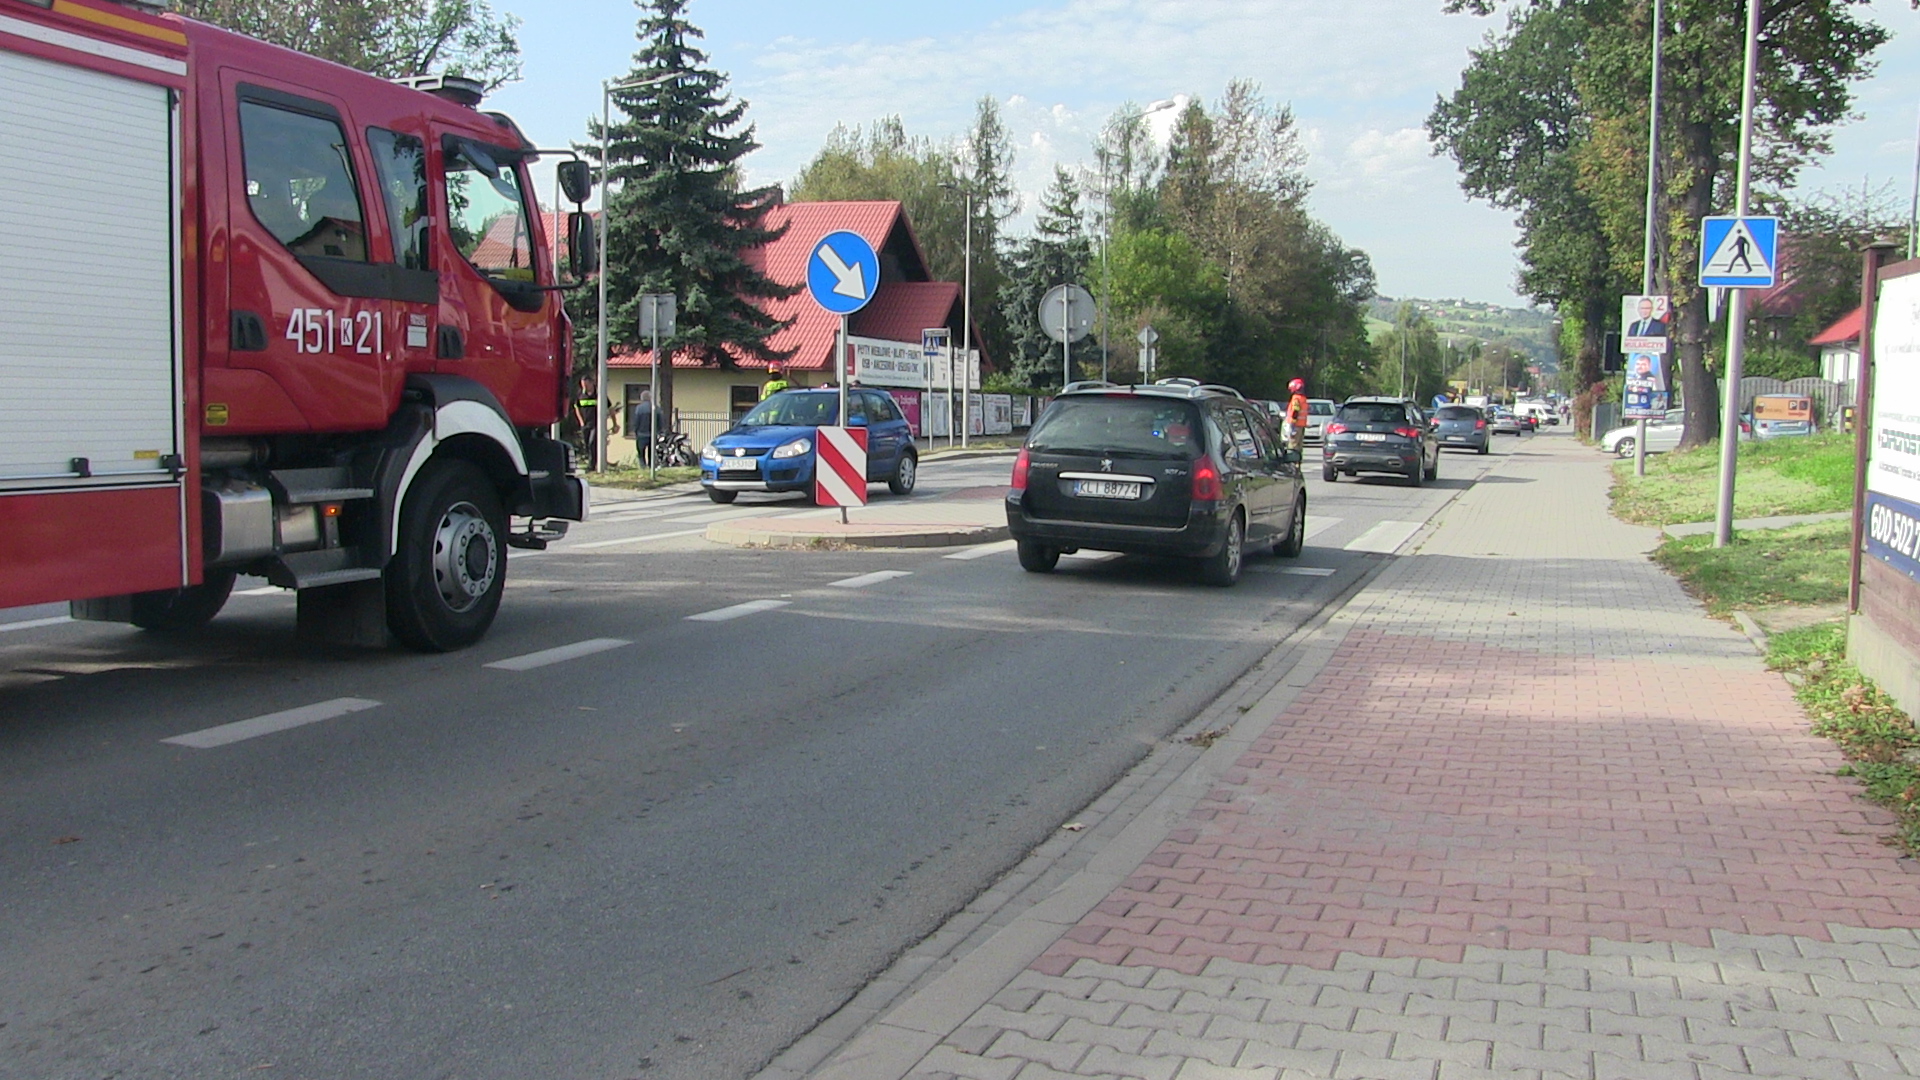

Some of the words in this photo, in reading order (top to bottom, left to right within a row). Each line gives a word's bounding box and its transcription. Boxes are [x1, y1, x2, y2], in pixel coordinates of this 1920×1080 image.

[1656, 297, 1665, 311] 2
[286, 308, 334, 354] 451
[342, 318, 353, 345] K
[356, 311, 384, 354] 21
[1104, 482, 1138, 496] 88774
[1871, 503, 1892, 544] 600
[1890, 512, 1914, 555] 502
